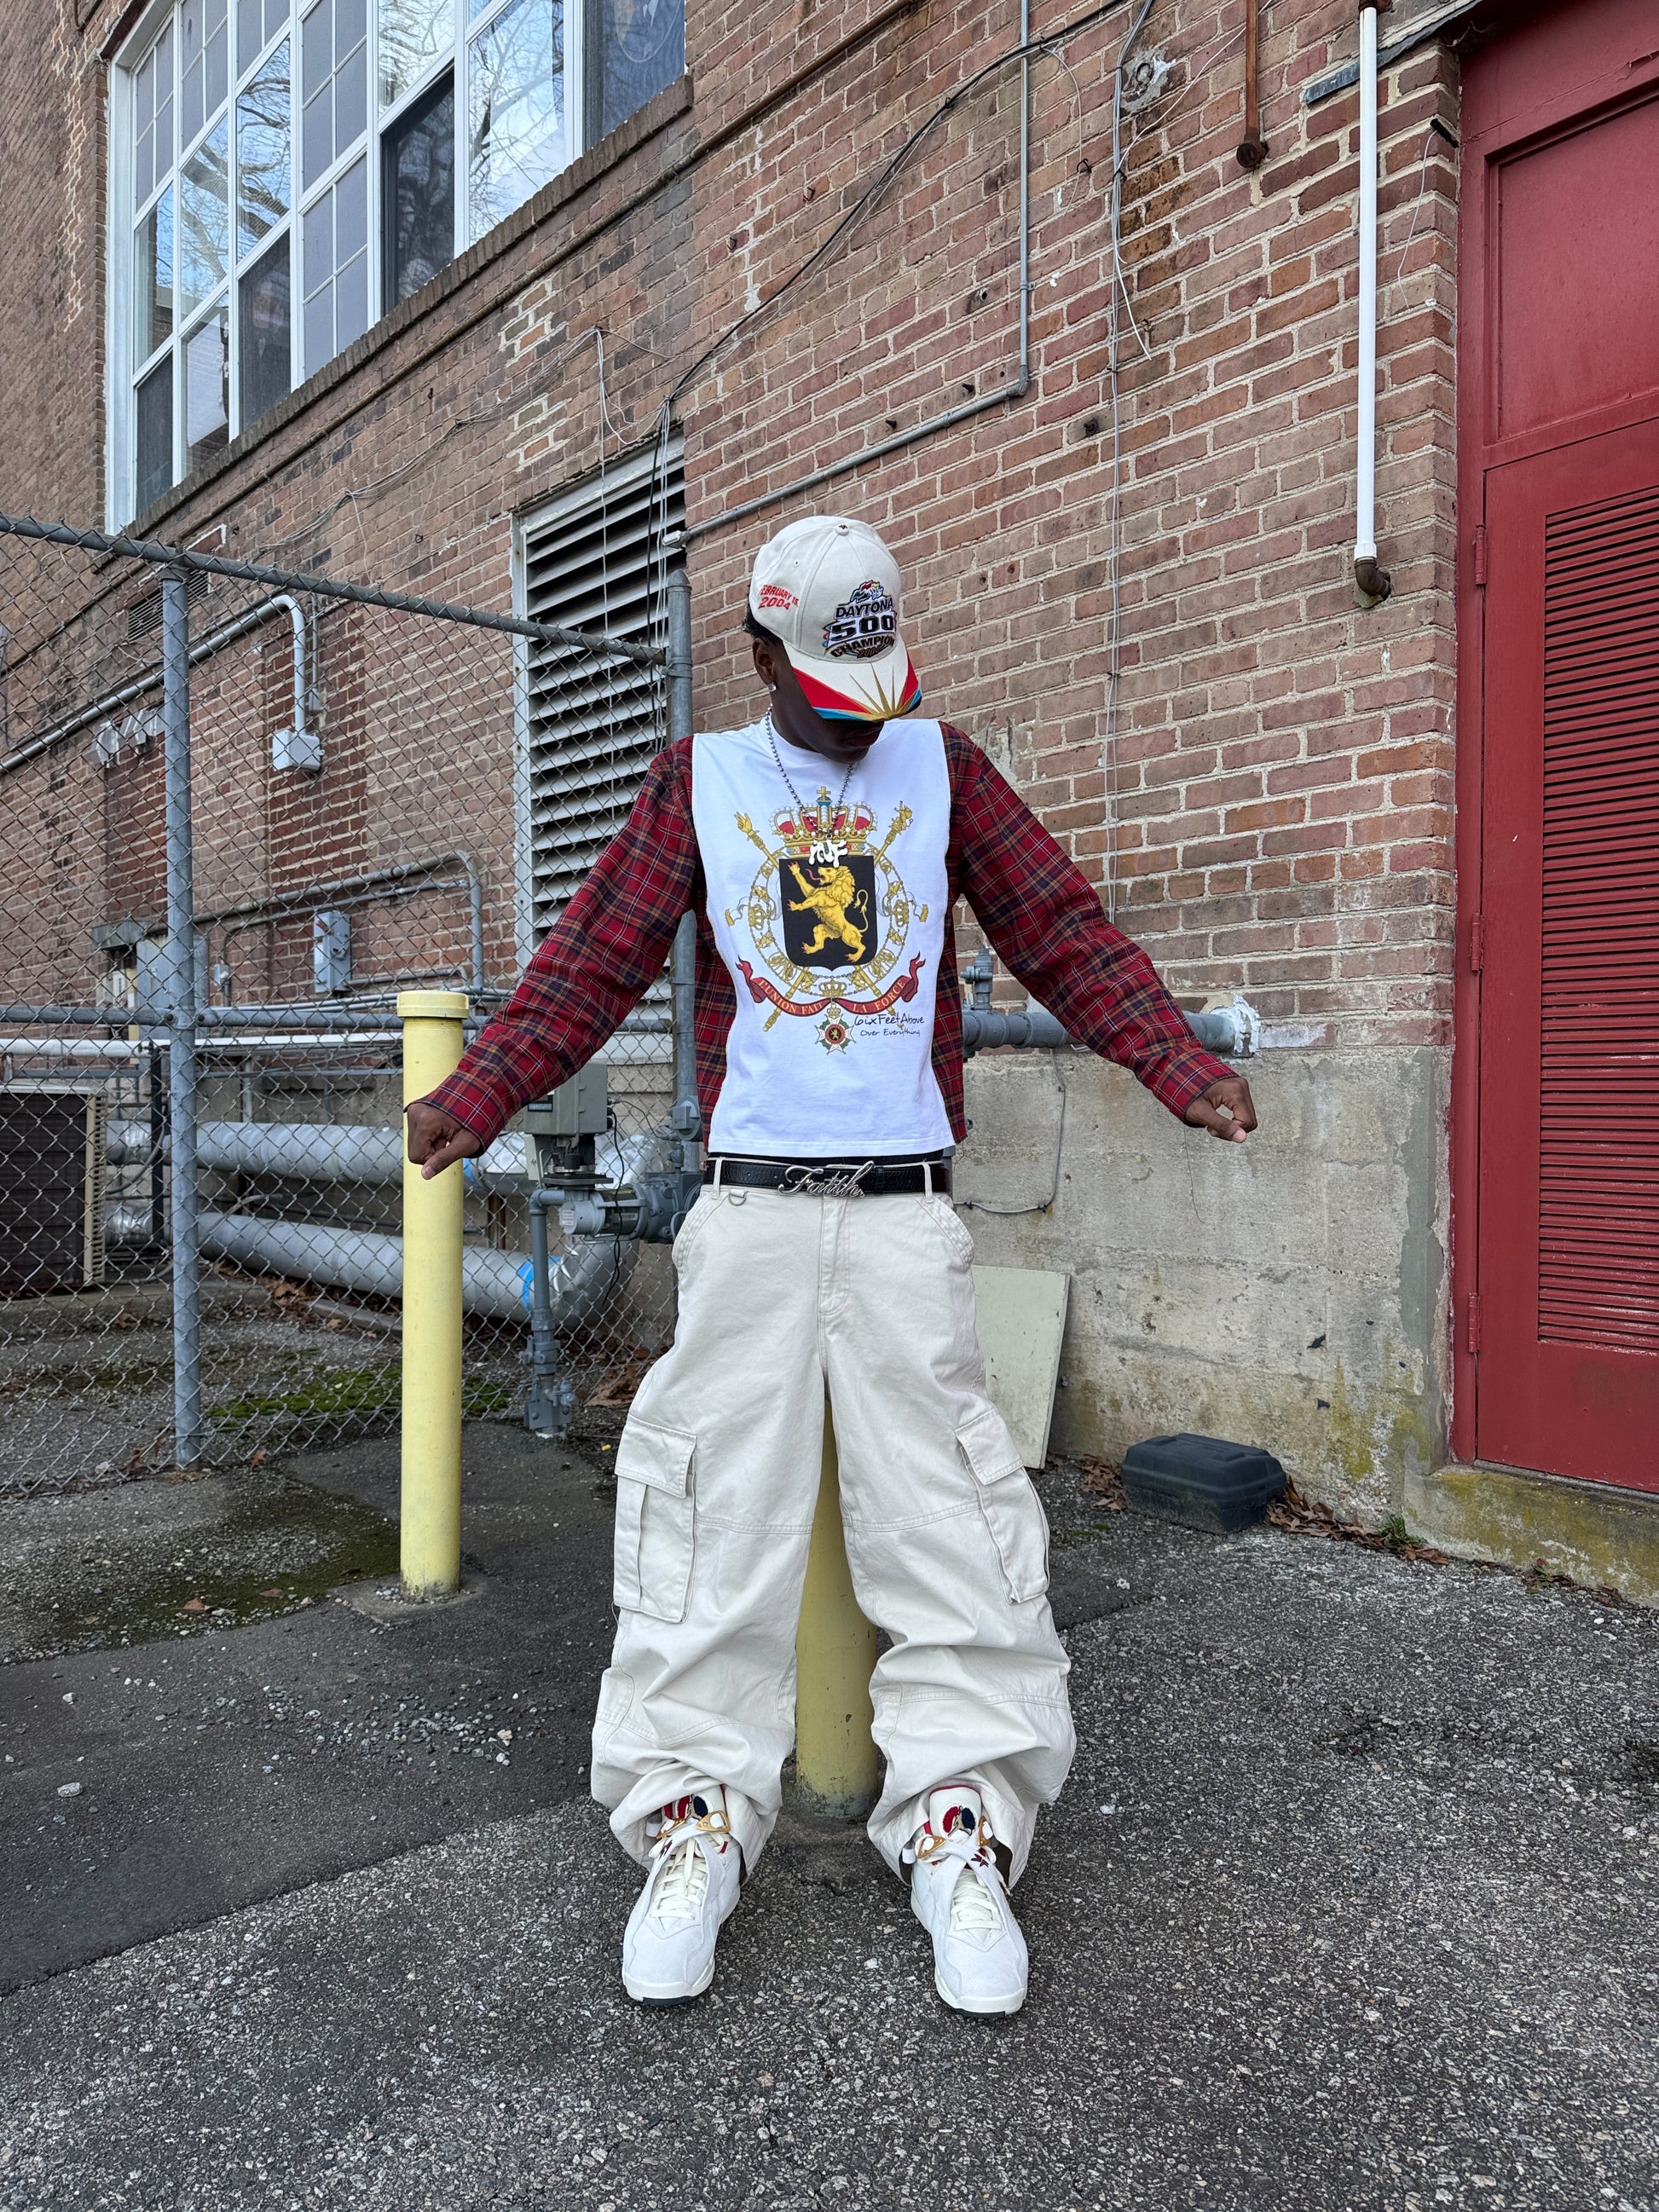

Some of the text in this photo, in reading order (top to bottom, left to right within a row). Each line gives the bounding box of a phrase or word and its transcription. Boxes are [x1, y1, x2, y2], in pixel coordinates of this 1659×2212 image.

[758, 584, 792, 600] EBRUARY
[758, 597, 791, 610] 2004
[835, 597, 893, 618] DAYTONA
[831, 615, 894, 641] 500
[801, 1002, 824, 1014] FAIT
[853, 1003, 868, 1014] LA
[875, 979, 905, 1011] FORCE
[883, 1028, 921, 1037] Everything
